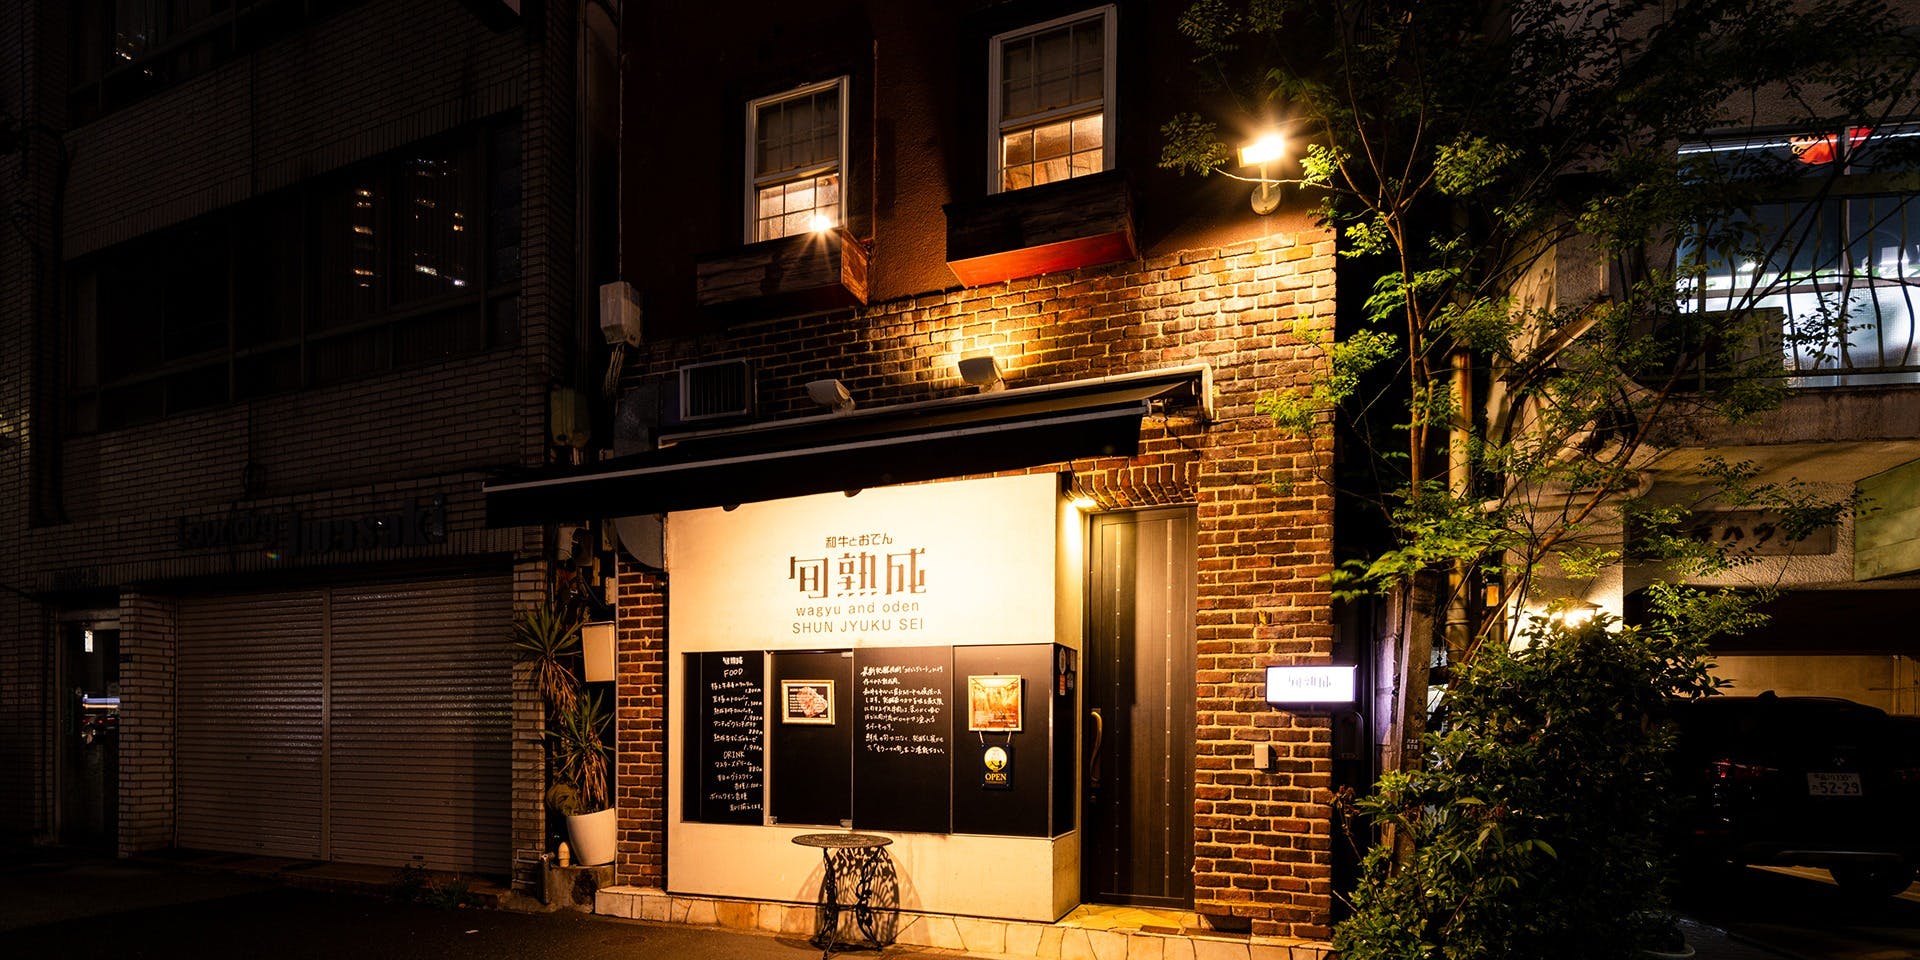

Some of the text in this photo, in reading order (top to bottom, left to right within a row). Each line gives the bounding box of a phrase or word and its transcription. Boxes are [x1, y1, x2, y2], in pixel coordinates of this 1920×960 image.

[825, 532, 893, 549] 和牛とおでん
[788, 547, 927, 599] 旬熟成
[796, 601, 919, 617] wagyu and oden
[792, 618, 923, 634] SHUN JYUKU SEI
[723, 668, 744, 678] FOOD
[723, 751, 746, 760] DRINK
[984, 772, 1007, 781] OPEN
